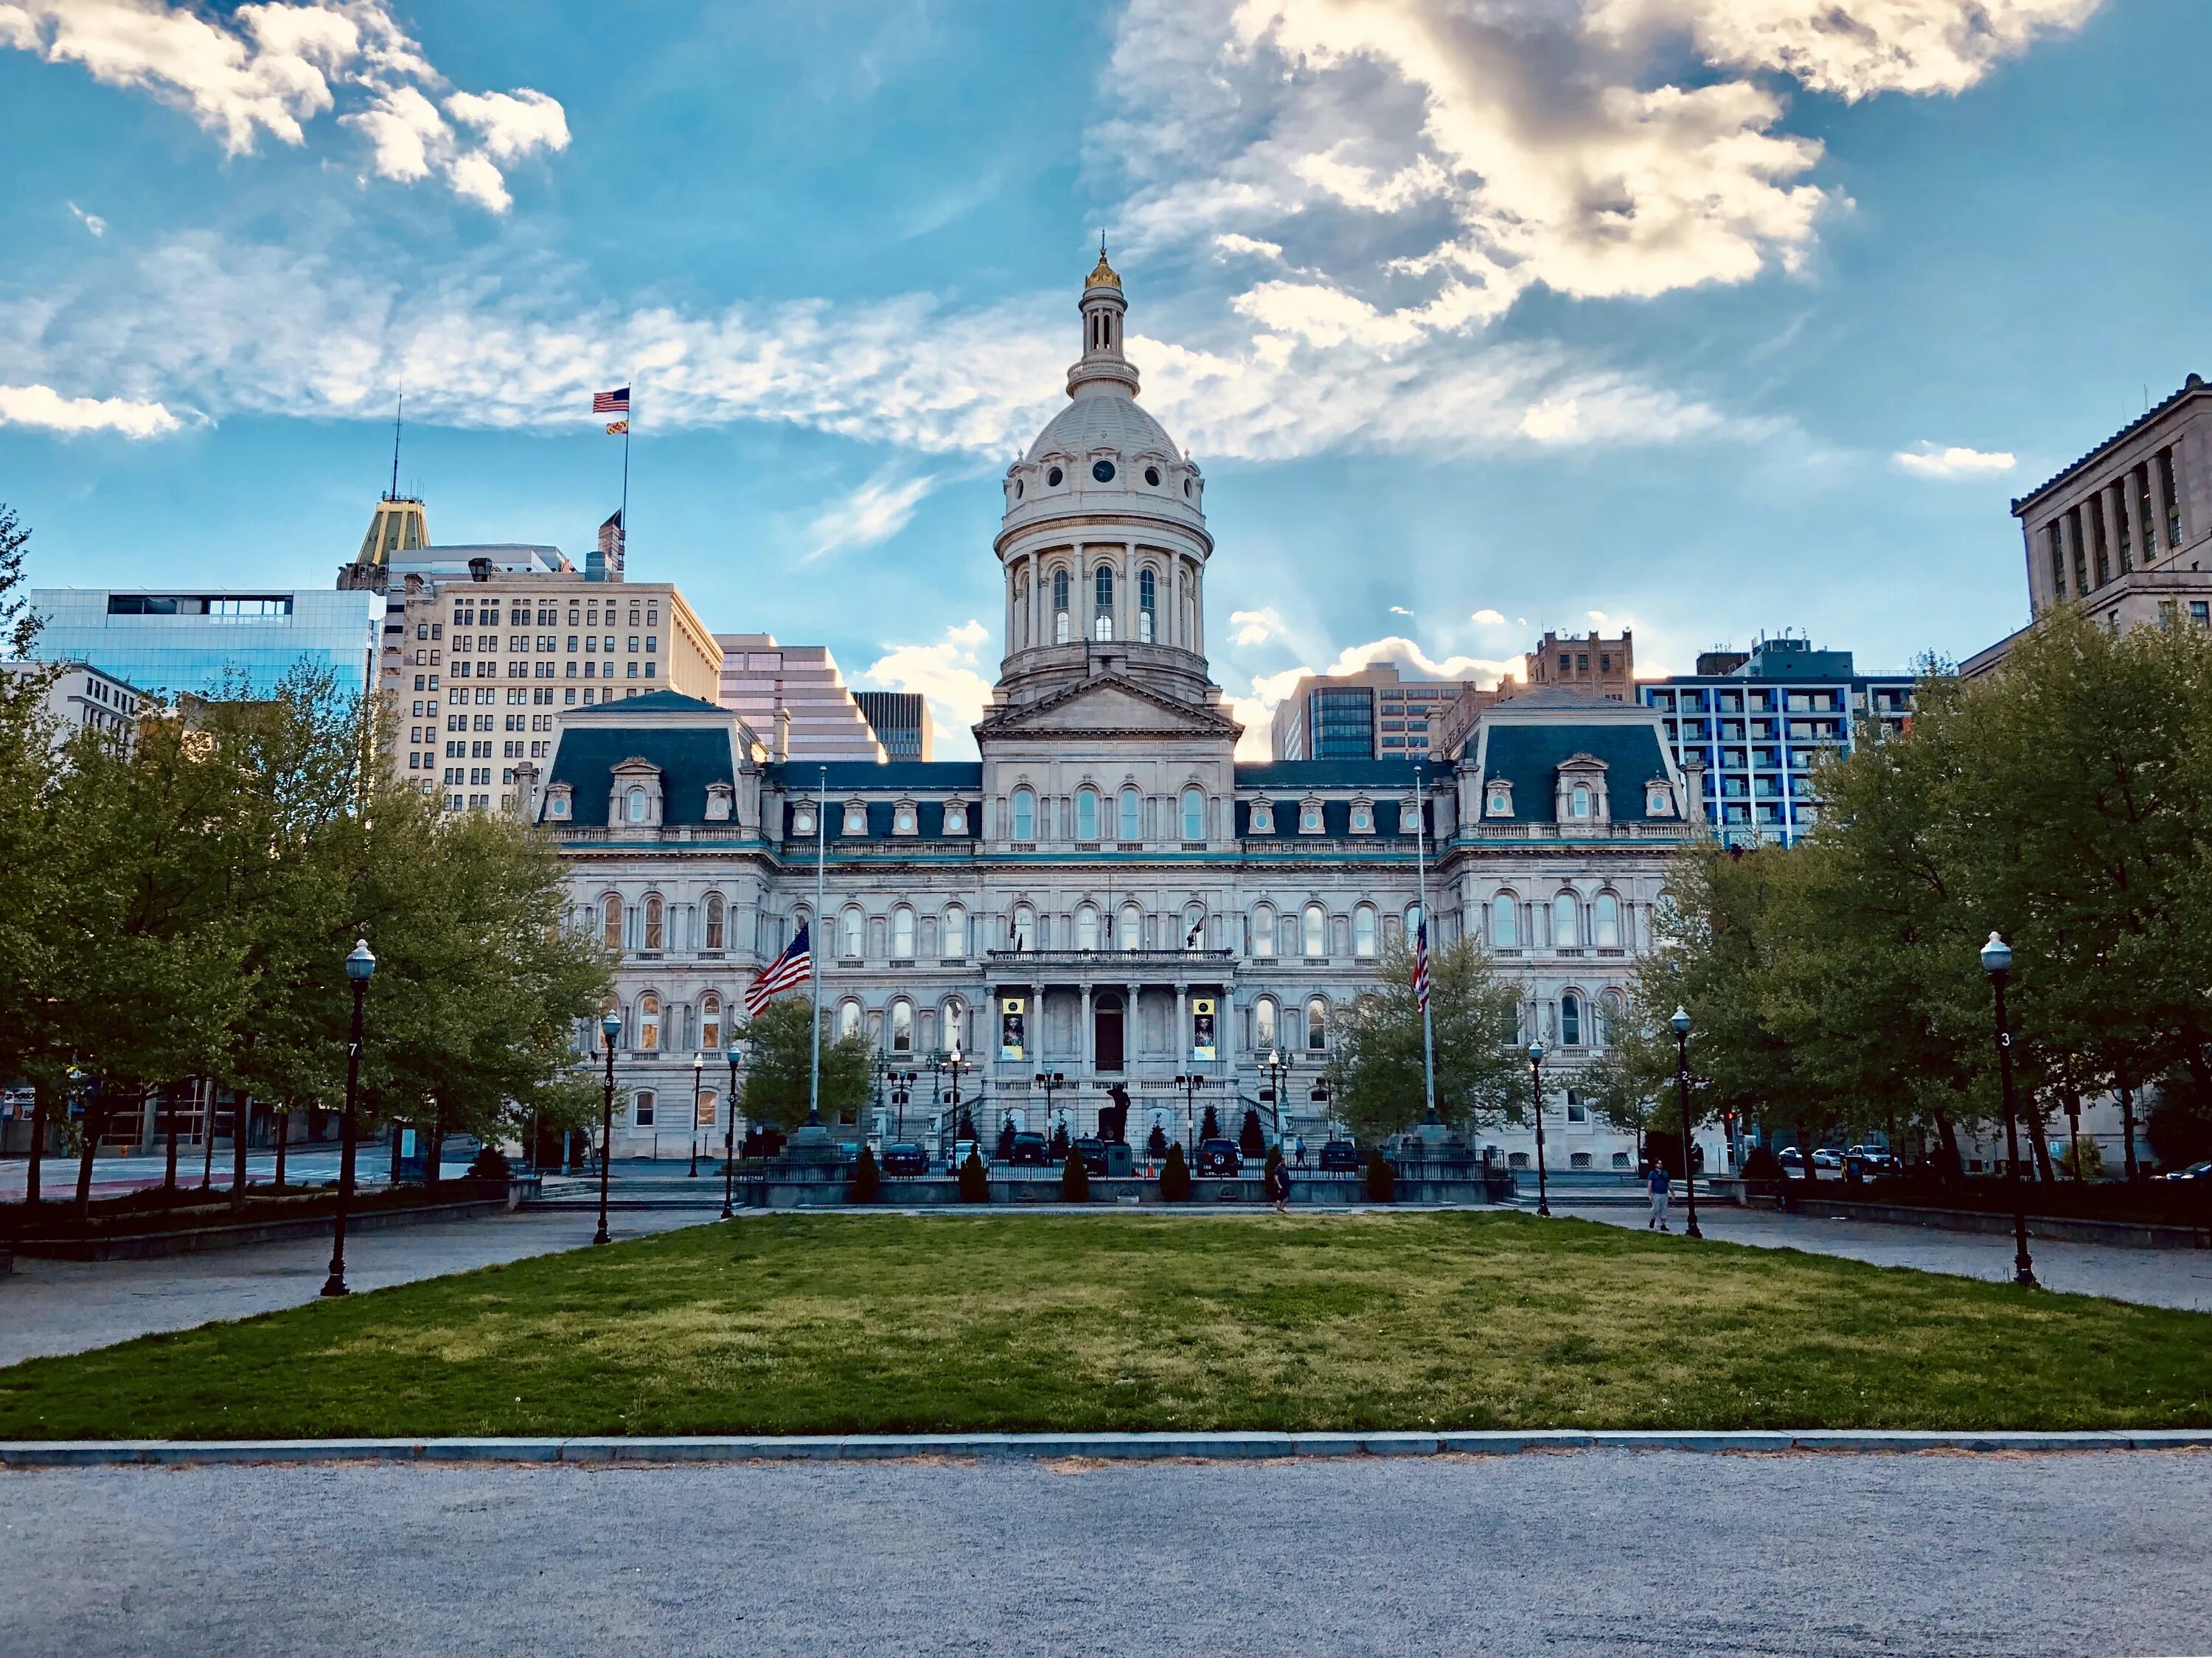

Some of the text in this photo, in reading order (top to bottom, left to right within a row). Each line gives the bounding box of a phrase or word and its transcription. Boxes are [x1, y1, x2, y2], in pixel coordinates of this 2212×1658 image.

[2001, 1033, 2010, 1046] 3
[349, 1043, 358, 1056] 7
[1682, 1071, 1688, 1080] 2
[605, 1078, 611, 1087] 6
